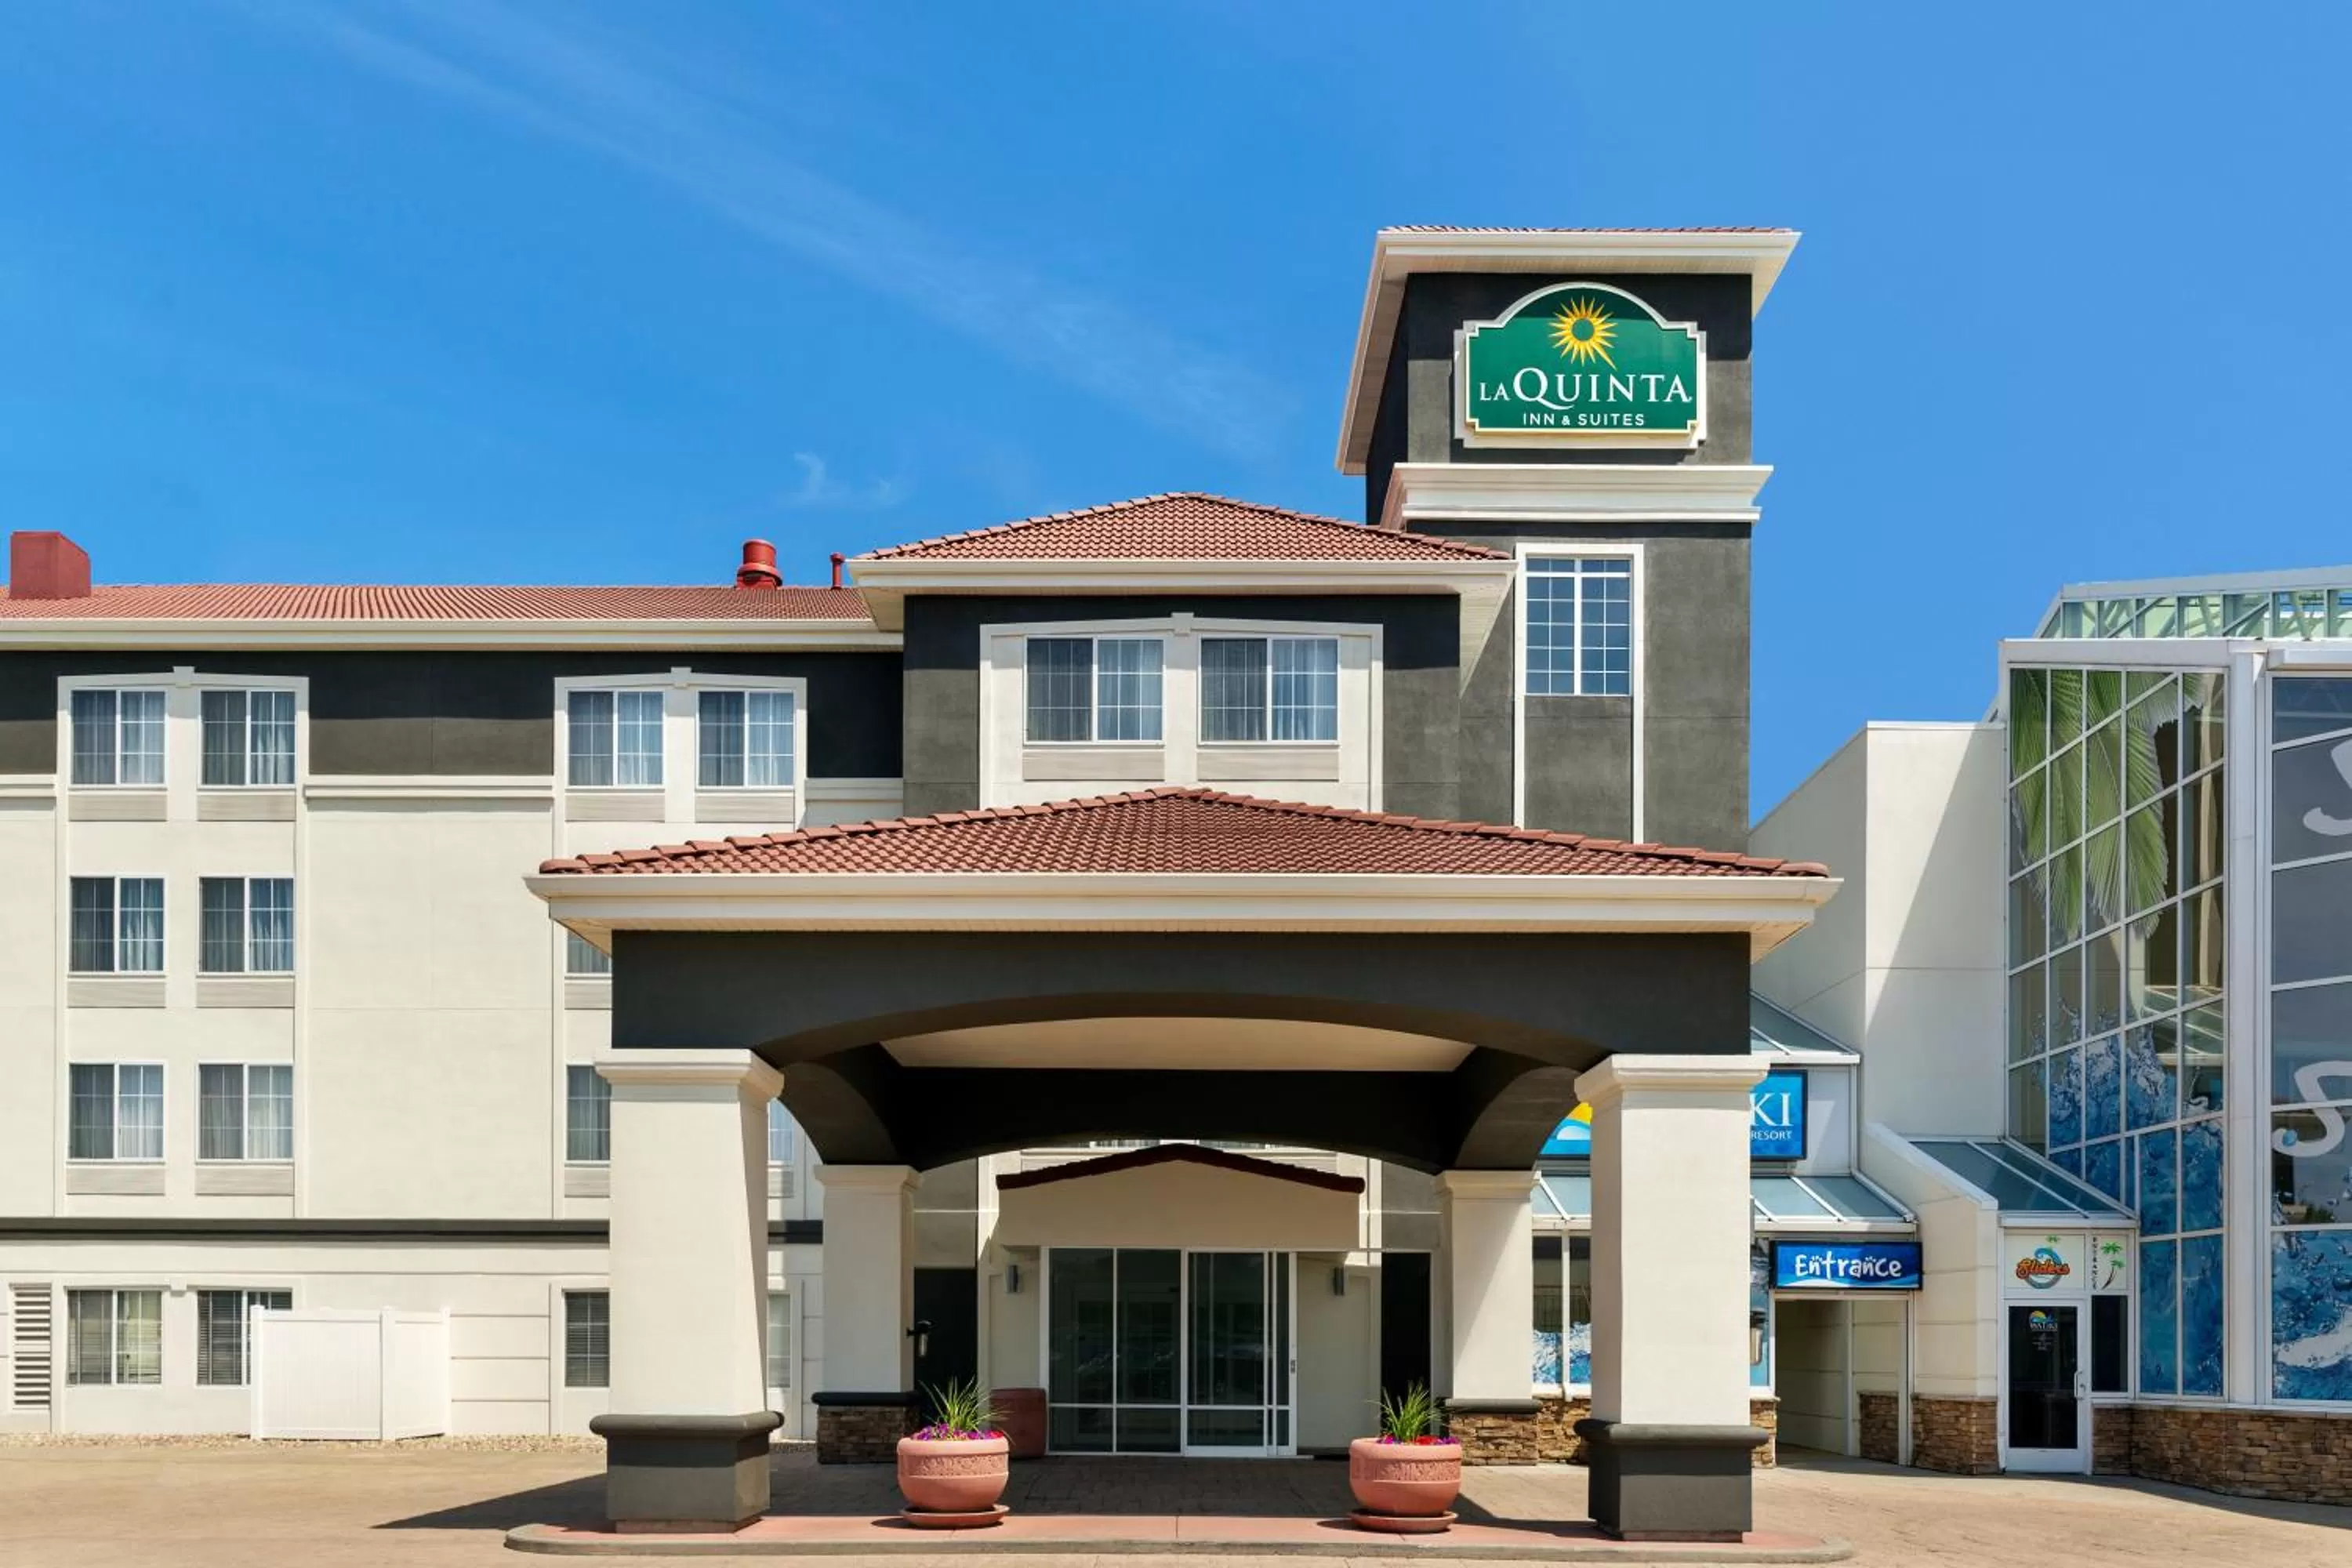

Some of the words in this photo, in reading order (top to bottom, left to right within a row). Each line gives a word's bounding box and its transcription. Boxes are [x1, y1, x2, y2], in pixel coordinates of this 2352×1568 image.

[1479, 383, 1510, 401] LA
[1513, 367, 1692, 410] QUINTA
[1523, 413, 1554, 426] INN
[1561, 415, 1570, 425] &
[1577, 413, 1644, 426] SUITES
[1751, 1130, 1793, 1141] RESORT
[1795, 1250, 1903, 1279] Entrance
